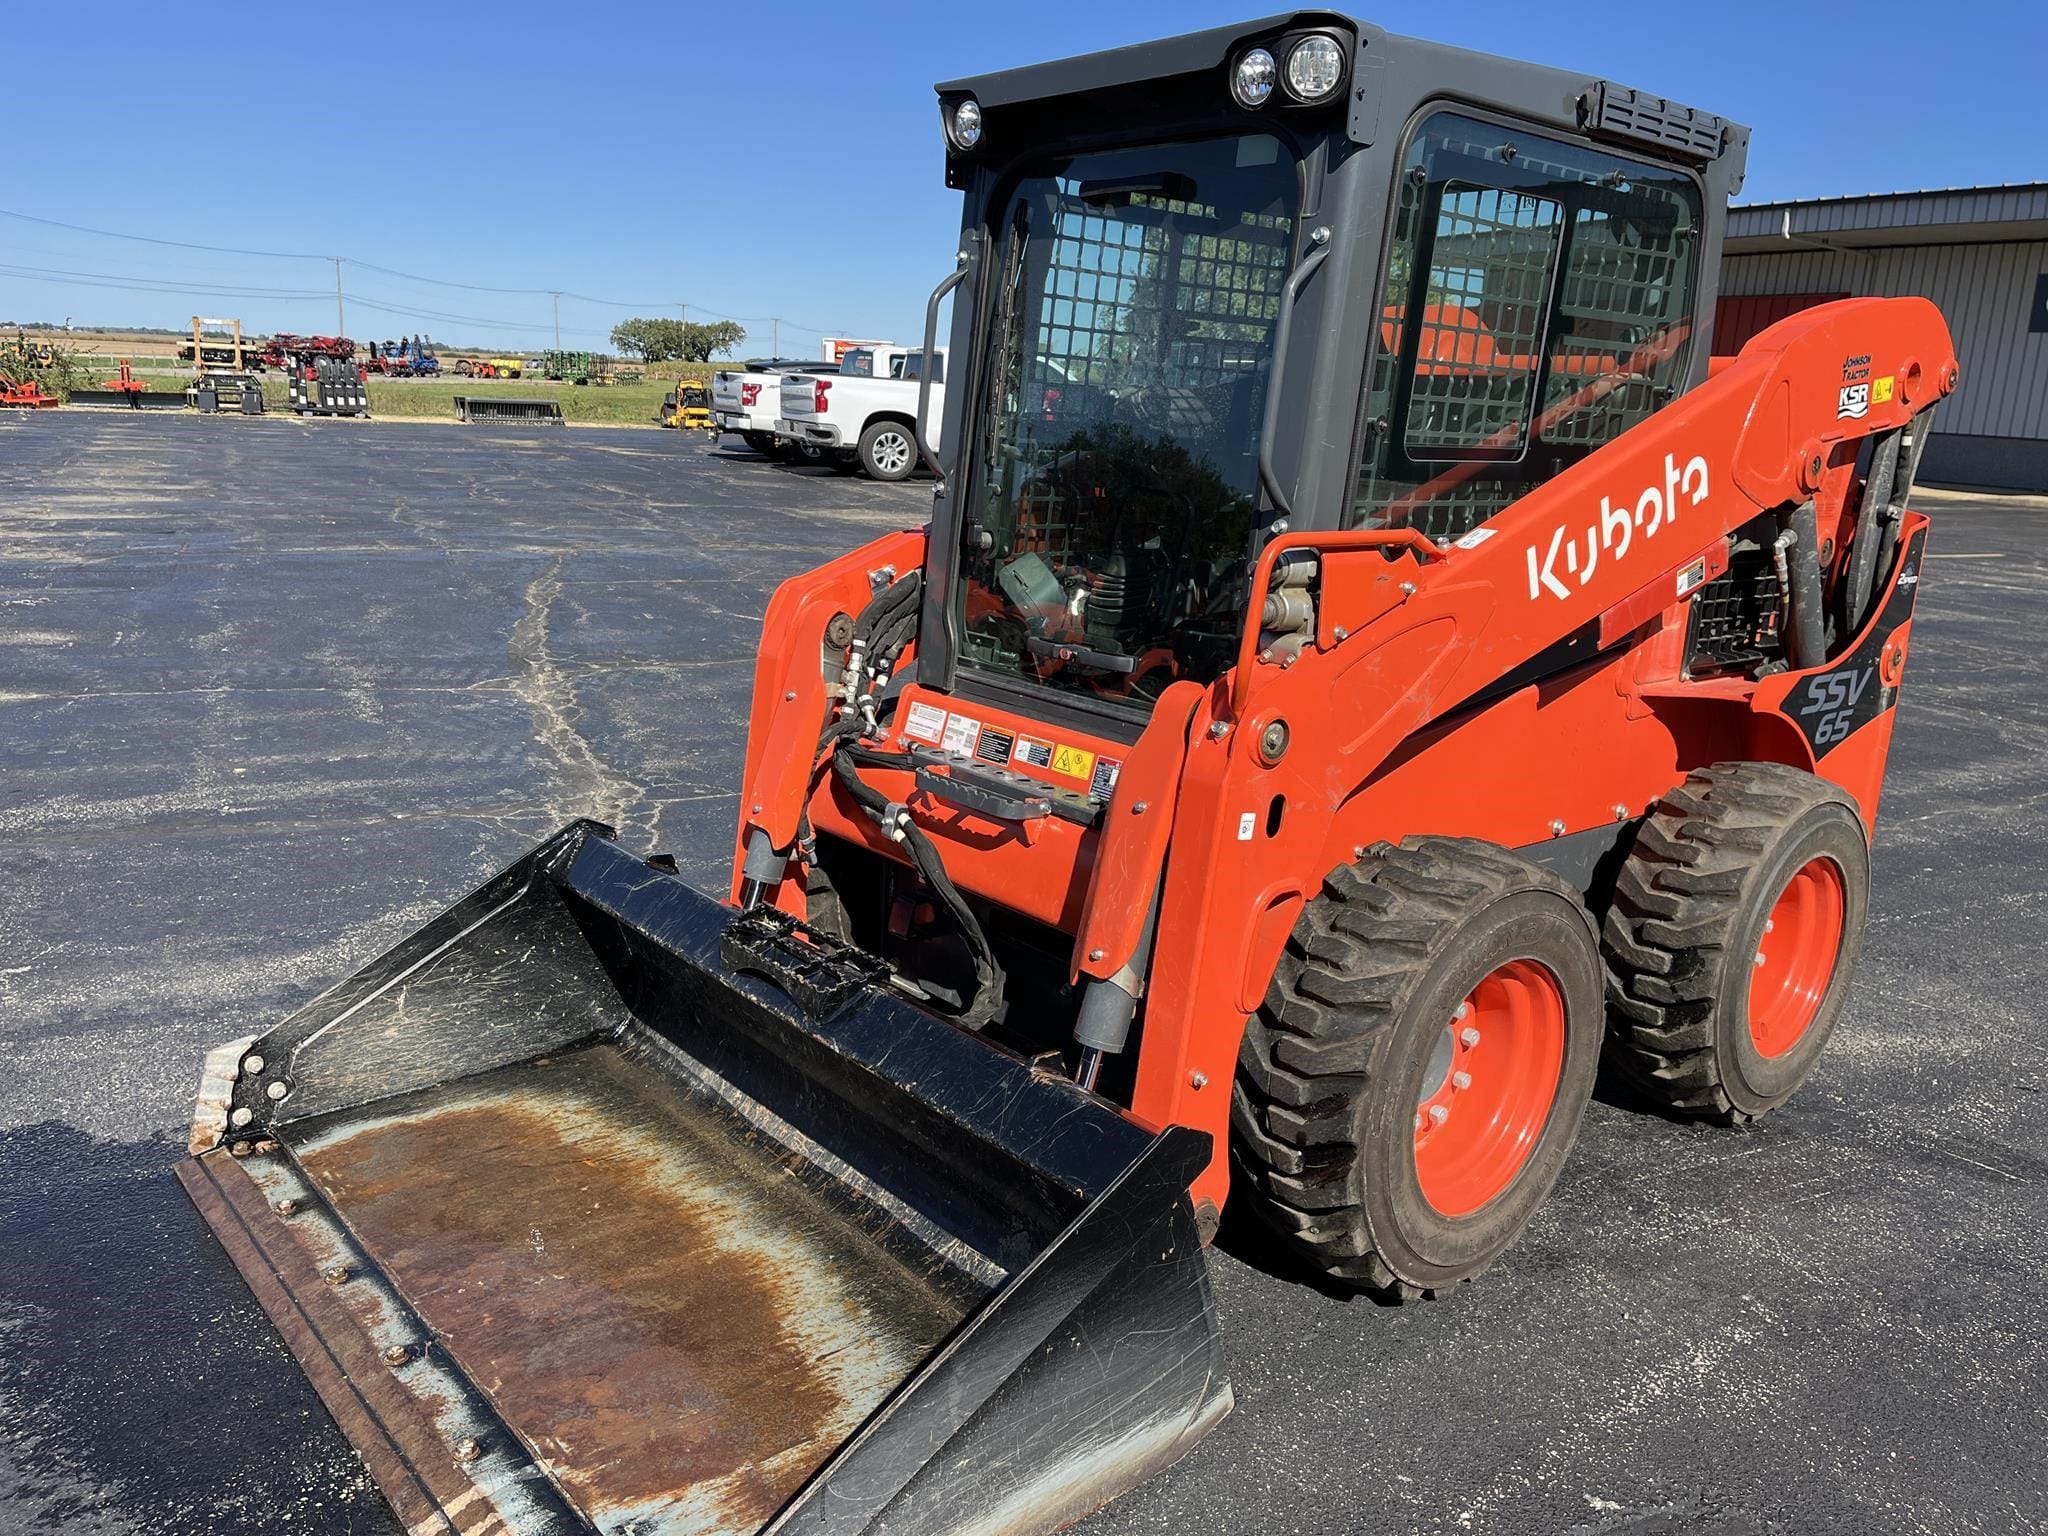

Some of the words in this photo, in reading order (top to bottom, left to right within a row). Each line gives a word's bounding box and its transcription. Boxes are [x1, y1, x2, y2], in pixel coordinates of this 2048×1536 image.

[1843, 355, 1872, 369] JOHNSON
[1843, 368, 1870, 382] TRACTOR
[1839, 383, 1869, 407] KSR
[1526, 453, 1709, 601] Kubota
[1800, 667, 1874, 715] SSV
[1815, 709, 1854, 744] 65
